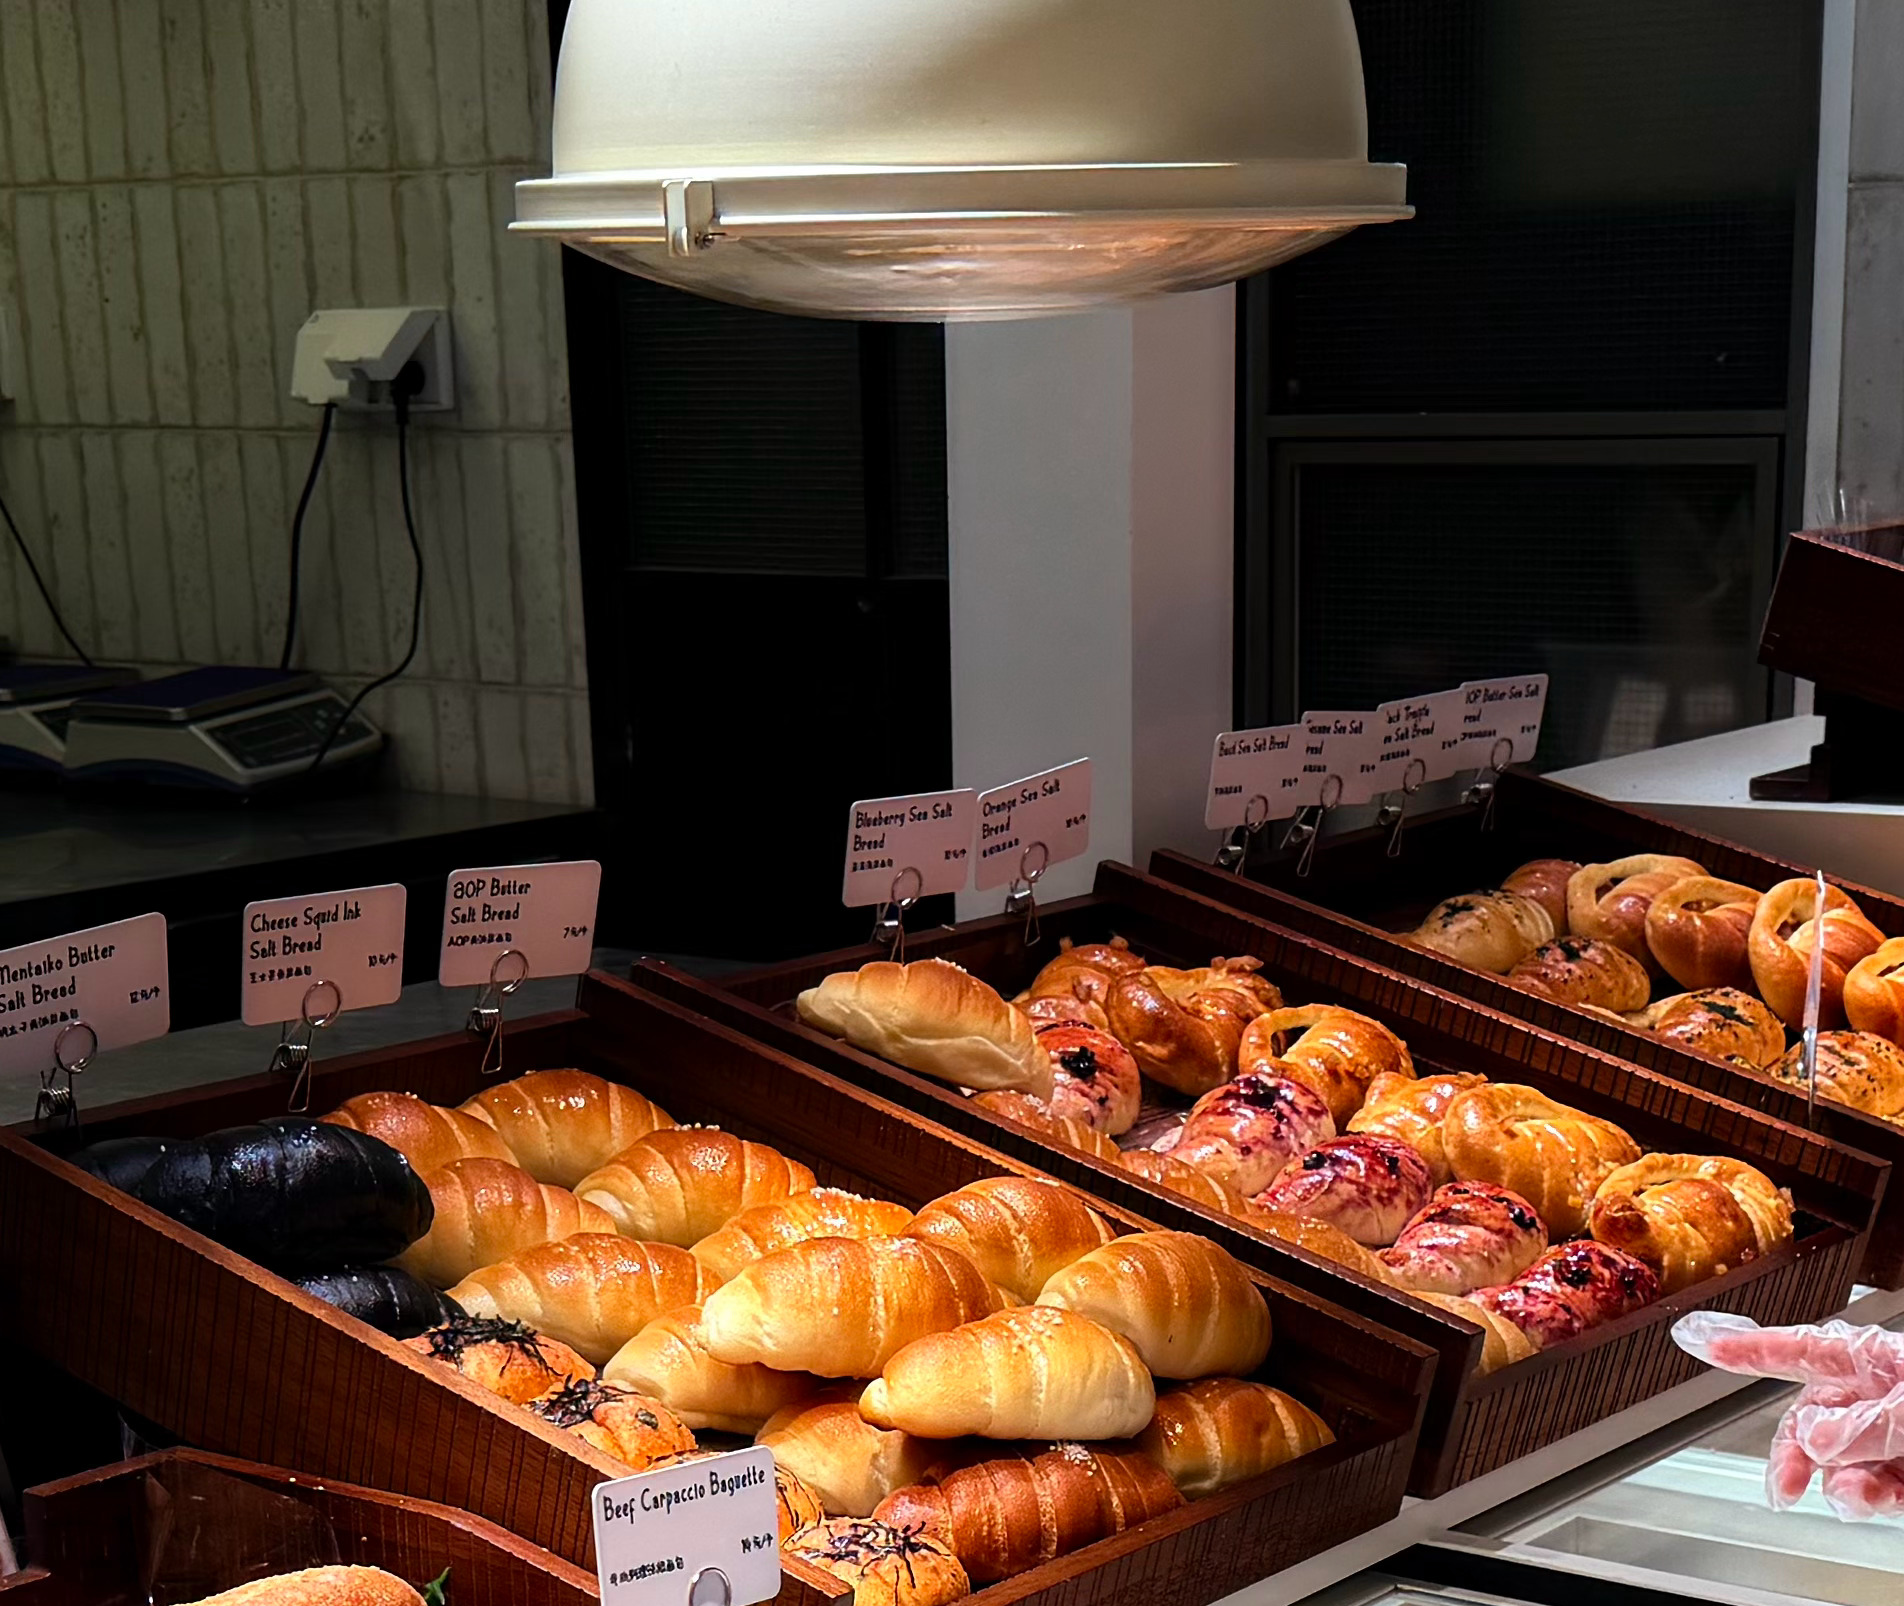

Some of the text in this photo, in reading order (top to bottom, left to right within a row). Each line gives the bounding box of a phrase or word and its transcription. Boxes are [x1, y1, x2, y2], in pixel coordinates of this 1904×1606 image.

[1464, 707, 1482, 723] read
[1306, 739, 1324, 755] read
[983, 778, 1060, 817] Orange Sea Salt
[855, 802, 953, 829] Blueberry Sea Salt
[982, 815, 1011, 839] Bread
[853, 833, 886, 852] Bread
[490, 877, 532, 897] Butter
[250, 900, 361, 933] Cheese Squid Ink
[450, 902, 521, 925] Salt Bread
[68, 944, 116, 968] Butter
[249, 932, 322, 960] Salt Bread
[32, 975, 77, 1005] Bread
[602, 1464, 766, 1525] Beef Carpaccio Baguette
